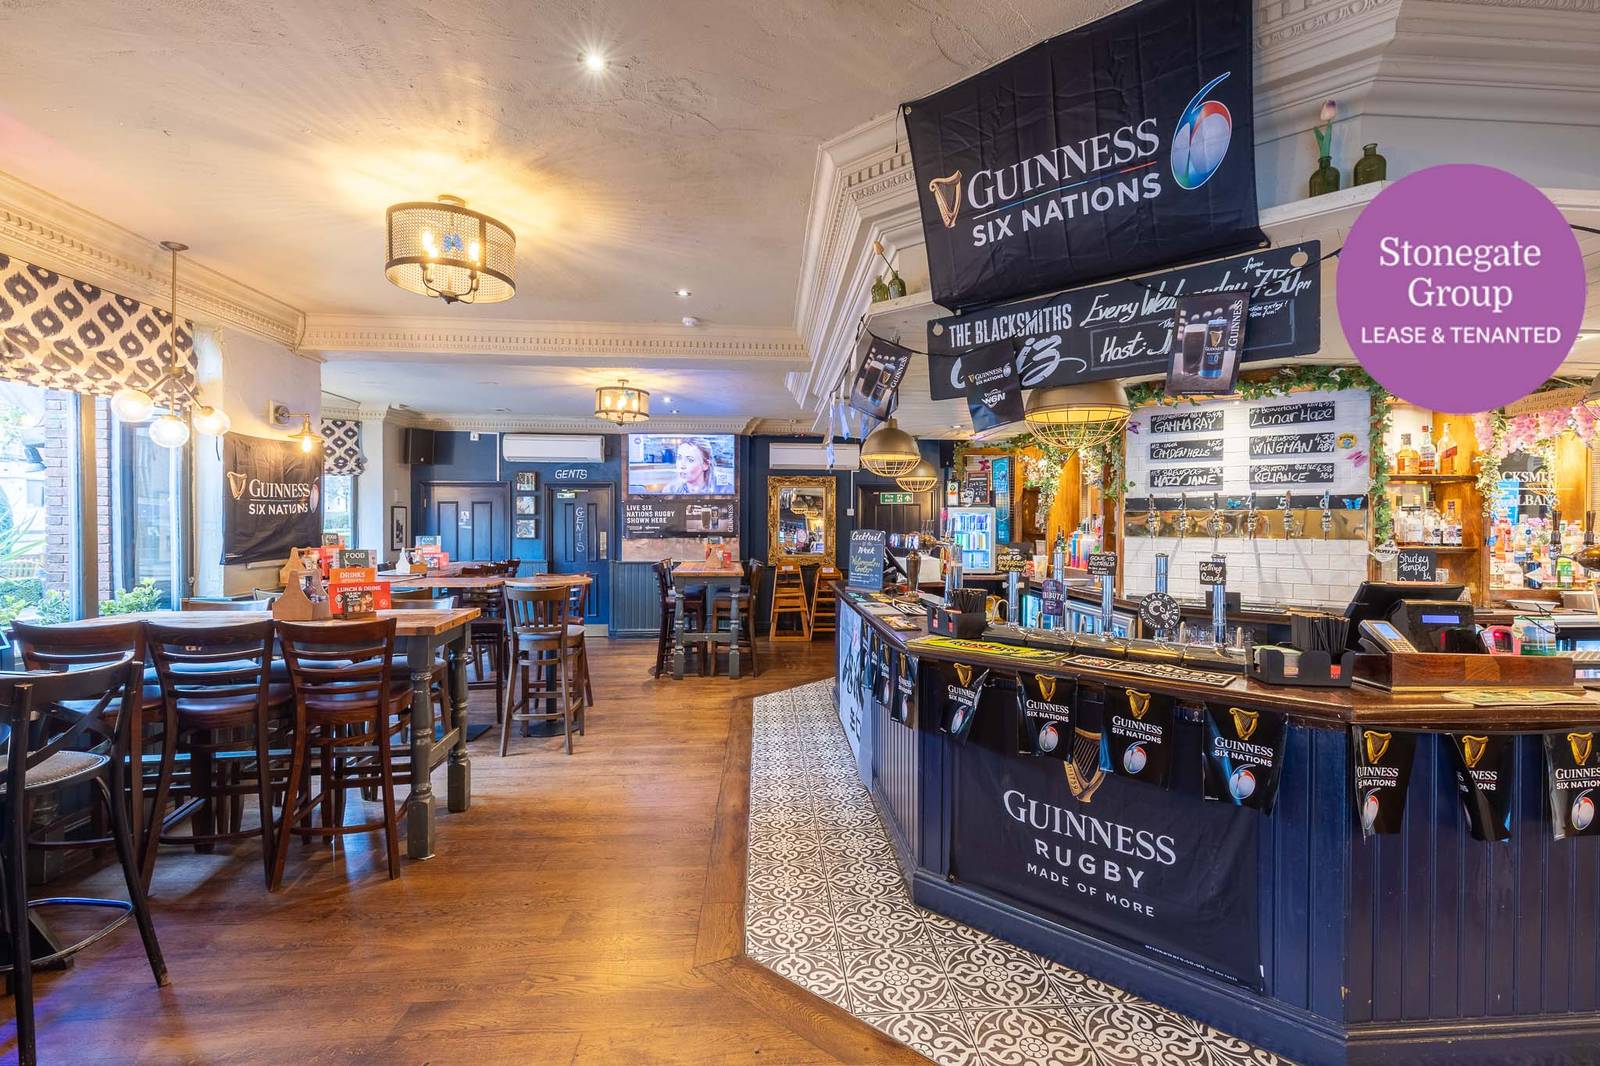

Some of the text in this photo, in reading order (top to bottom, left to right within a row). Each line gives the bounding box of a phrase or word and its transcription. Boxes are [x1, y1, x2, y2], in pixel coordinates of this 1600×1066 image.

[968, 118, 1160, 209] GUINNESS
[972, 172, 1162, 247] SIX NATIONS
[1080, 293, 1140, 327] Every
[948, 303, 1072, 348] THE BLACKSMITHS
[1228, 299, 1243, 347] GUINNESS
[1101, 331, 1147, 363] Host:
[890, 356, 908, 388] GUINNESS
[974, 366, 1003, 380] GUINNESS
[1154, 414, 1217, 433] GAMMA RAY
[1250, 408, 1333, 427] Lunar Haze
[1252, 439, 1313, 455] WINGMAN
[555, 469, 588, 480] GENTS
[1153, 472, 1218, 486] HAZY JANE
[1254, 470, 1310, 482] RELIANCE
[249, 478, 310, 498] GUINNESS
[248, 503, 308, 515] SIX NATIONS
[575, 506, 585, 553] GENTS
[1400, 552, 1429, 570] Shirley
[1141, 593, 1179, 629] BLACK SHEEP
[1026, 699, 1070, 714] GUINNESS
[1026, 710, 1070, 723] SIX NATIONS
[1112, 715, 1163, 736] GUINNESS
[1112, 727, 1162, 744] SIX NATIONS
[1214, 736, 1274, 758] GUINNESS
[1214, 749, 1273, 768] SIX NATIONS
[1555, 767, 1600, 779] GUINNES
[1363, 779, 1397, 787] NATIONS
[1556, 780, 1600, 790] SIX NATION
[1003, 789, 1176, 865] GUINNESS
[1034, 838, 1145, 888] RUGBY
[1027, 862, 1155, 918] MADE OF MORE
